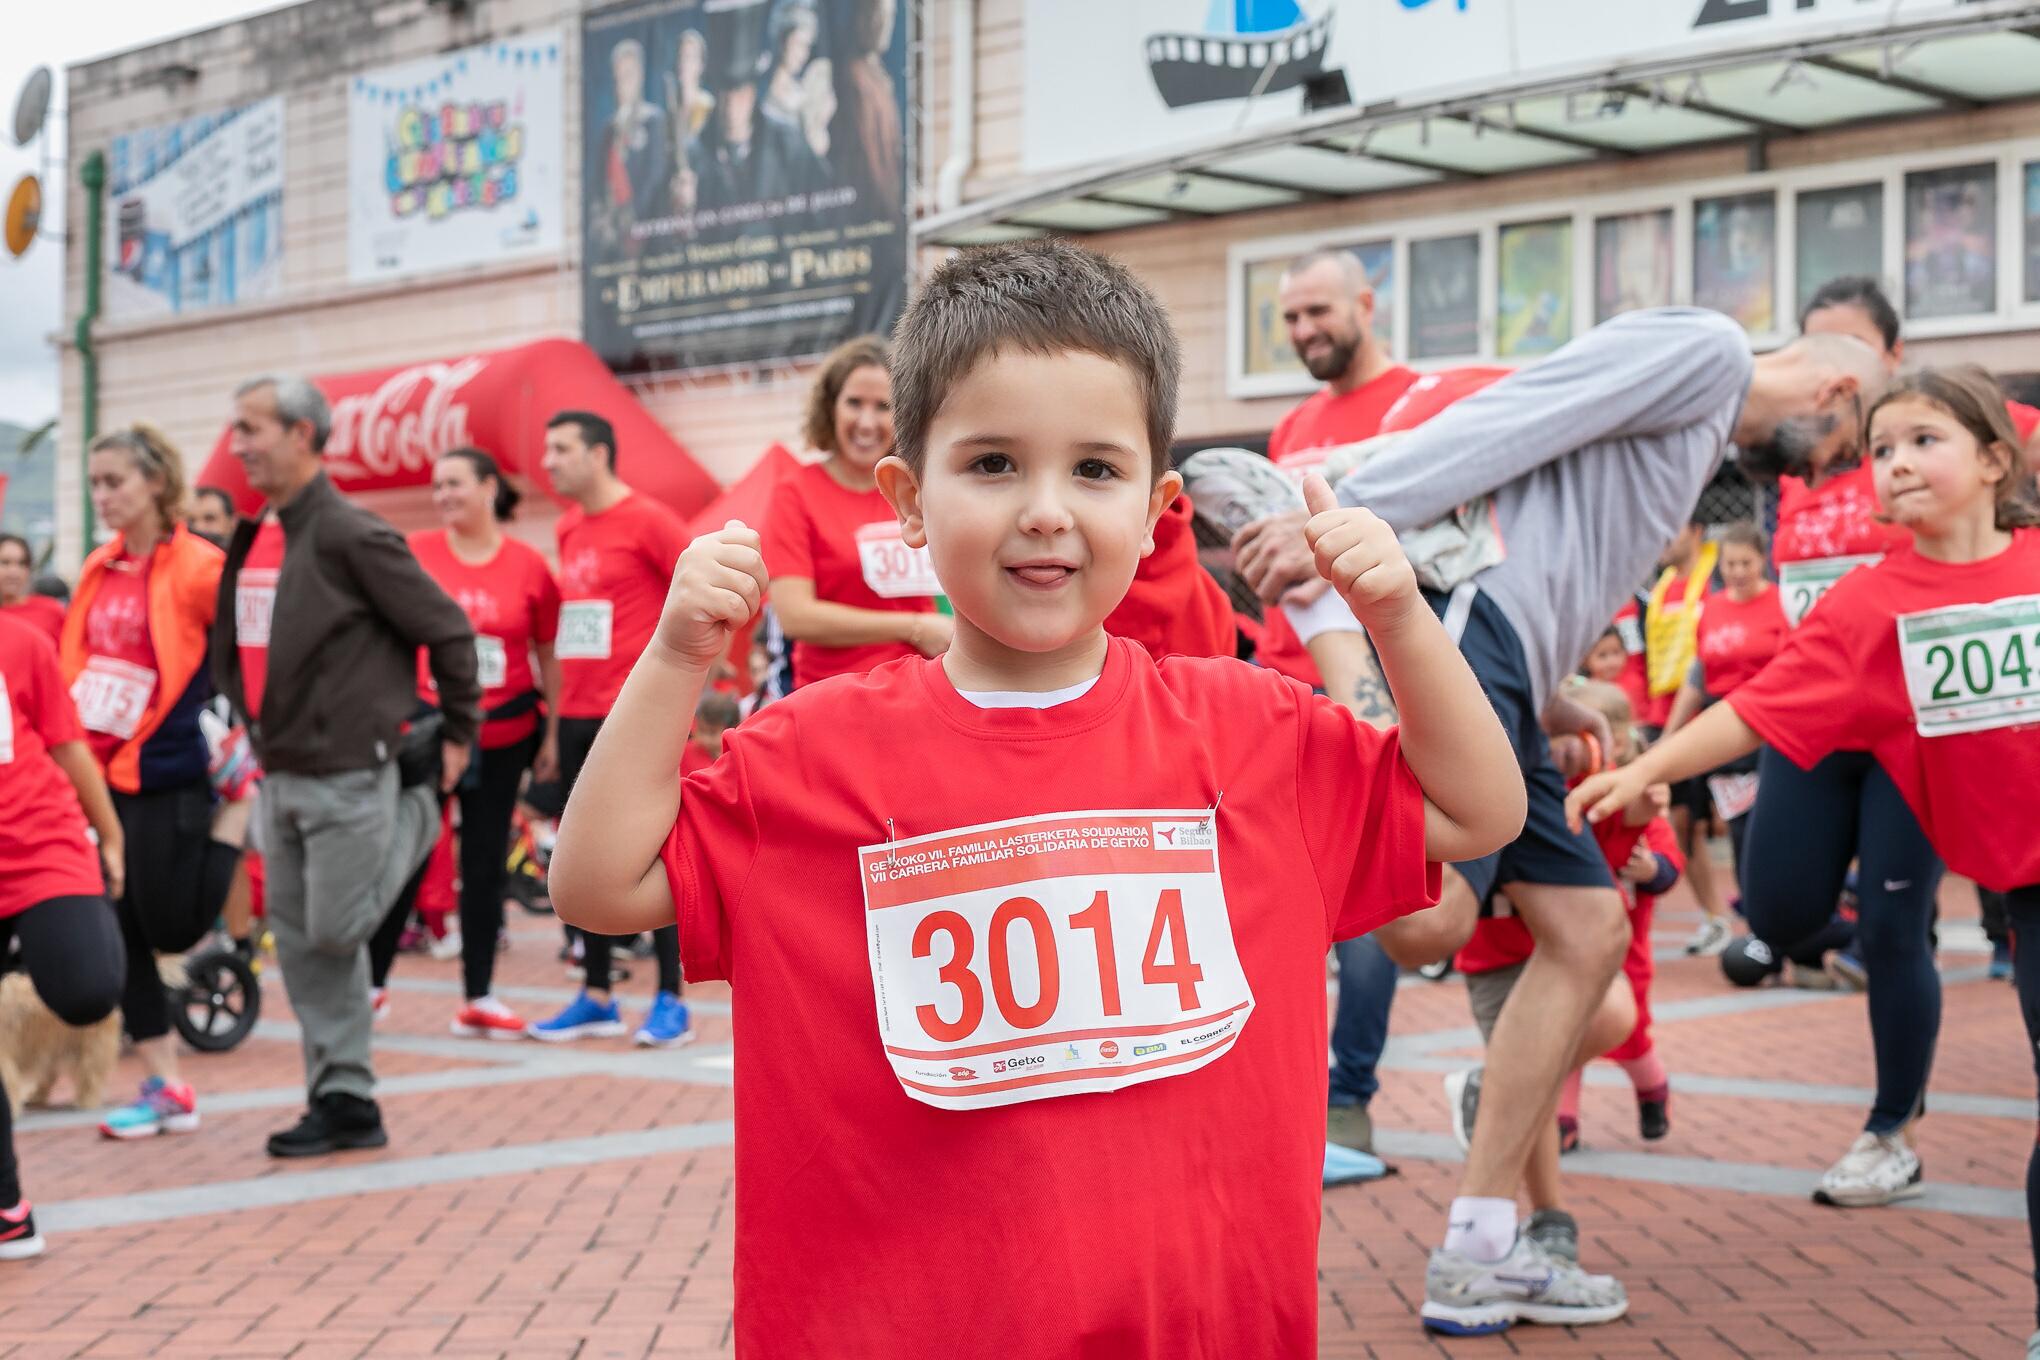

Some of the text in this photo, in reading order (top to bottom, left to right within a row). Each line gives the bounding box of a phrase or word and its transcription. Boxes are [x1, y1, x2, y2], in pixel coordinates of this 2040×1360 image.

[949, 840, 997, 858] FAMILIA
[999, 829, 1080, 849] LASTERKETA
[1081, 827, 1148, 838] SOLIDARIOA
[1179, 827, 1212, 838] Seguro
[1180, 837, 1211, 846] Bilbao
[870, 837, 1149, 884] VII CARRERA FAMILIAR SOLIDARIA DE GETXO
[911, 889, 1204, 1042] 3014
[1193, 1023, 1232, 1043] CORREO
[1007, 1055, 1045, 1068] Getxo
